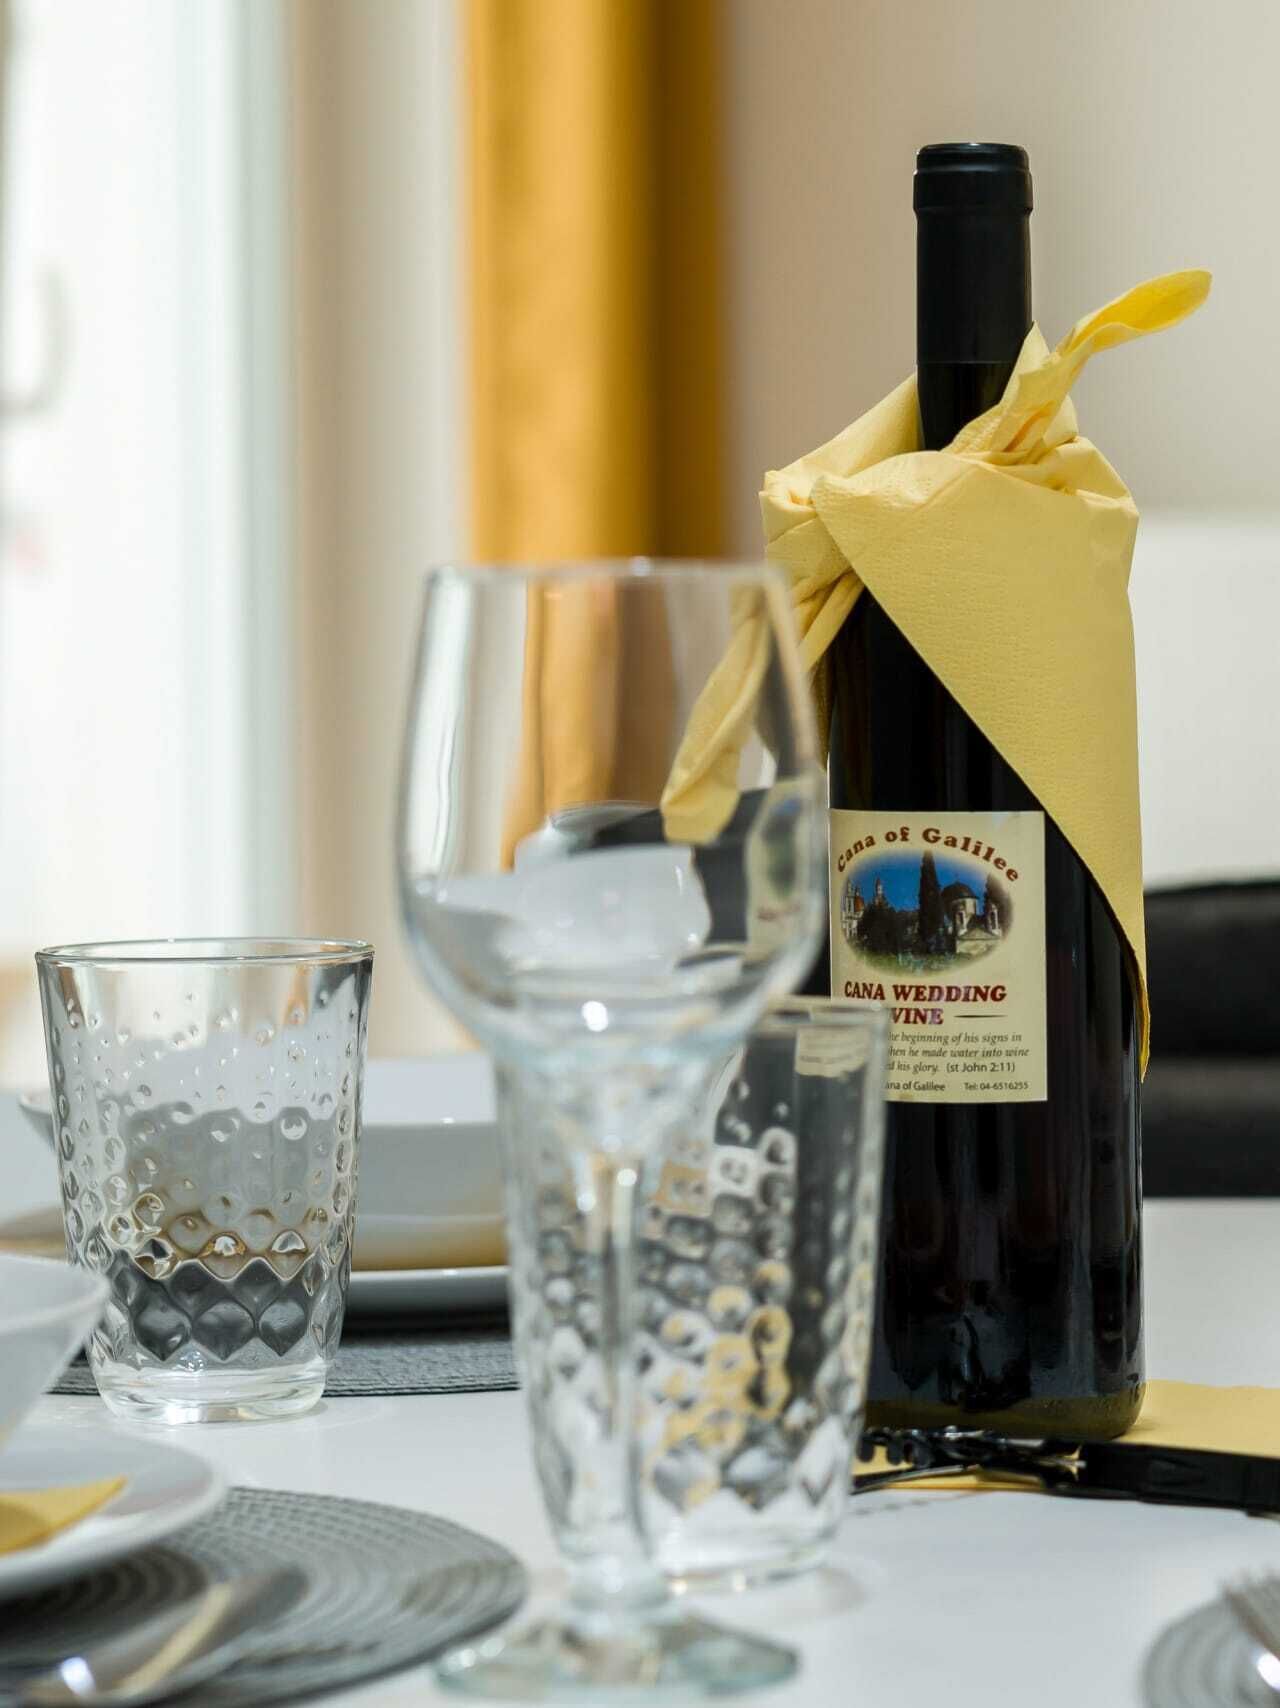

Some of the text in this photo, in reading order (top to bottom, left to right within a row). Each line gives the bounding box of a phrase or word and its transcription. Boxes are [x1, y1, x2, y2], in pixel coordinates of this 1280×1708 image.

[838, 827, 1019, 882] Cana of Galilee
[844, 981, 1007, 1002] CANA WEDDING
[902, 1032, 949, 1046] beginning
[951, 1031, 963, 1046] of
[964, 1032, 979, 1043] his
[981, 1032, 1008, 1046] signs
[1011, 1033, 1022, 1042] in
[889, 1045, 1030, 1058] hen he made water into wine
[897, 1060, 910, 1072] his
[961, 1062, 988, 1073] John
[902, 1080, 912, 1091] of
[913, 1081, 946, 1092] Galilee
